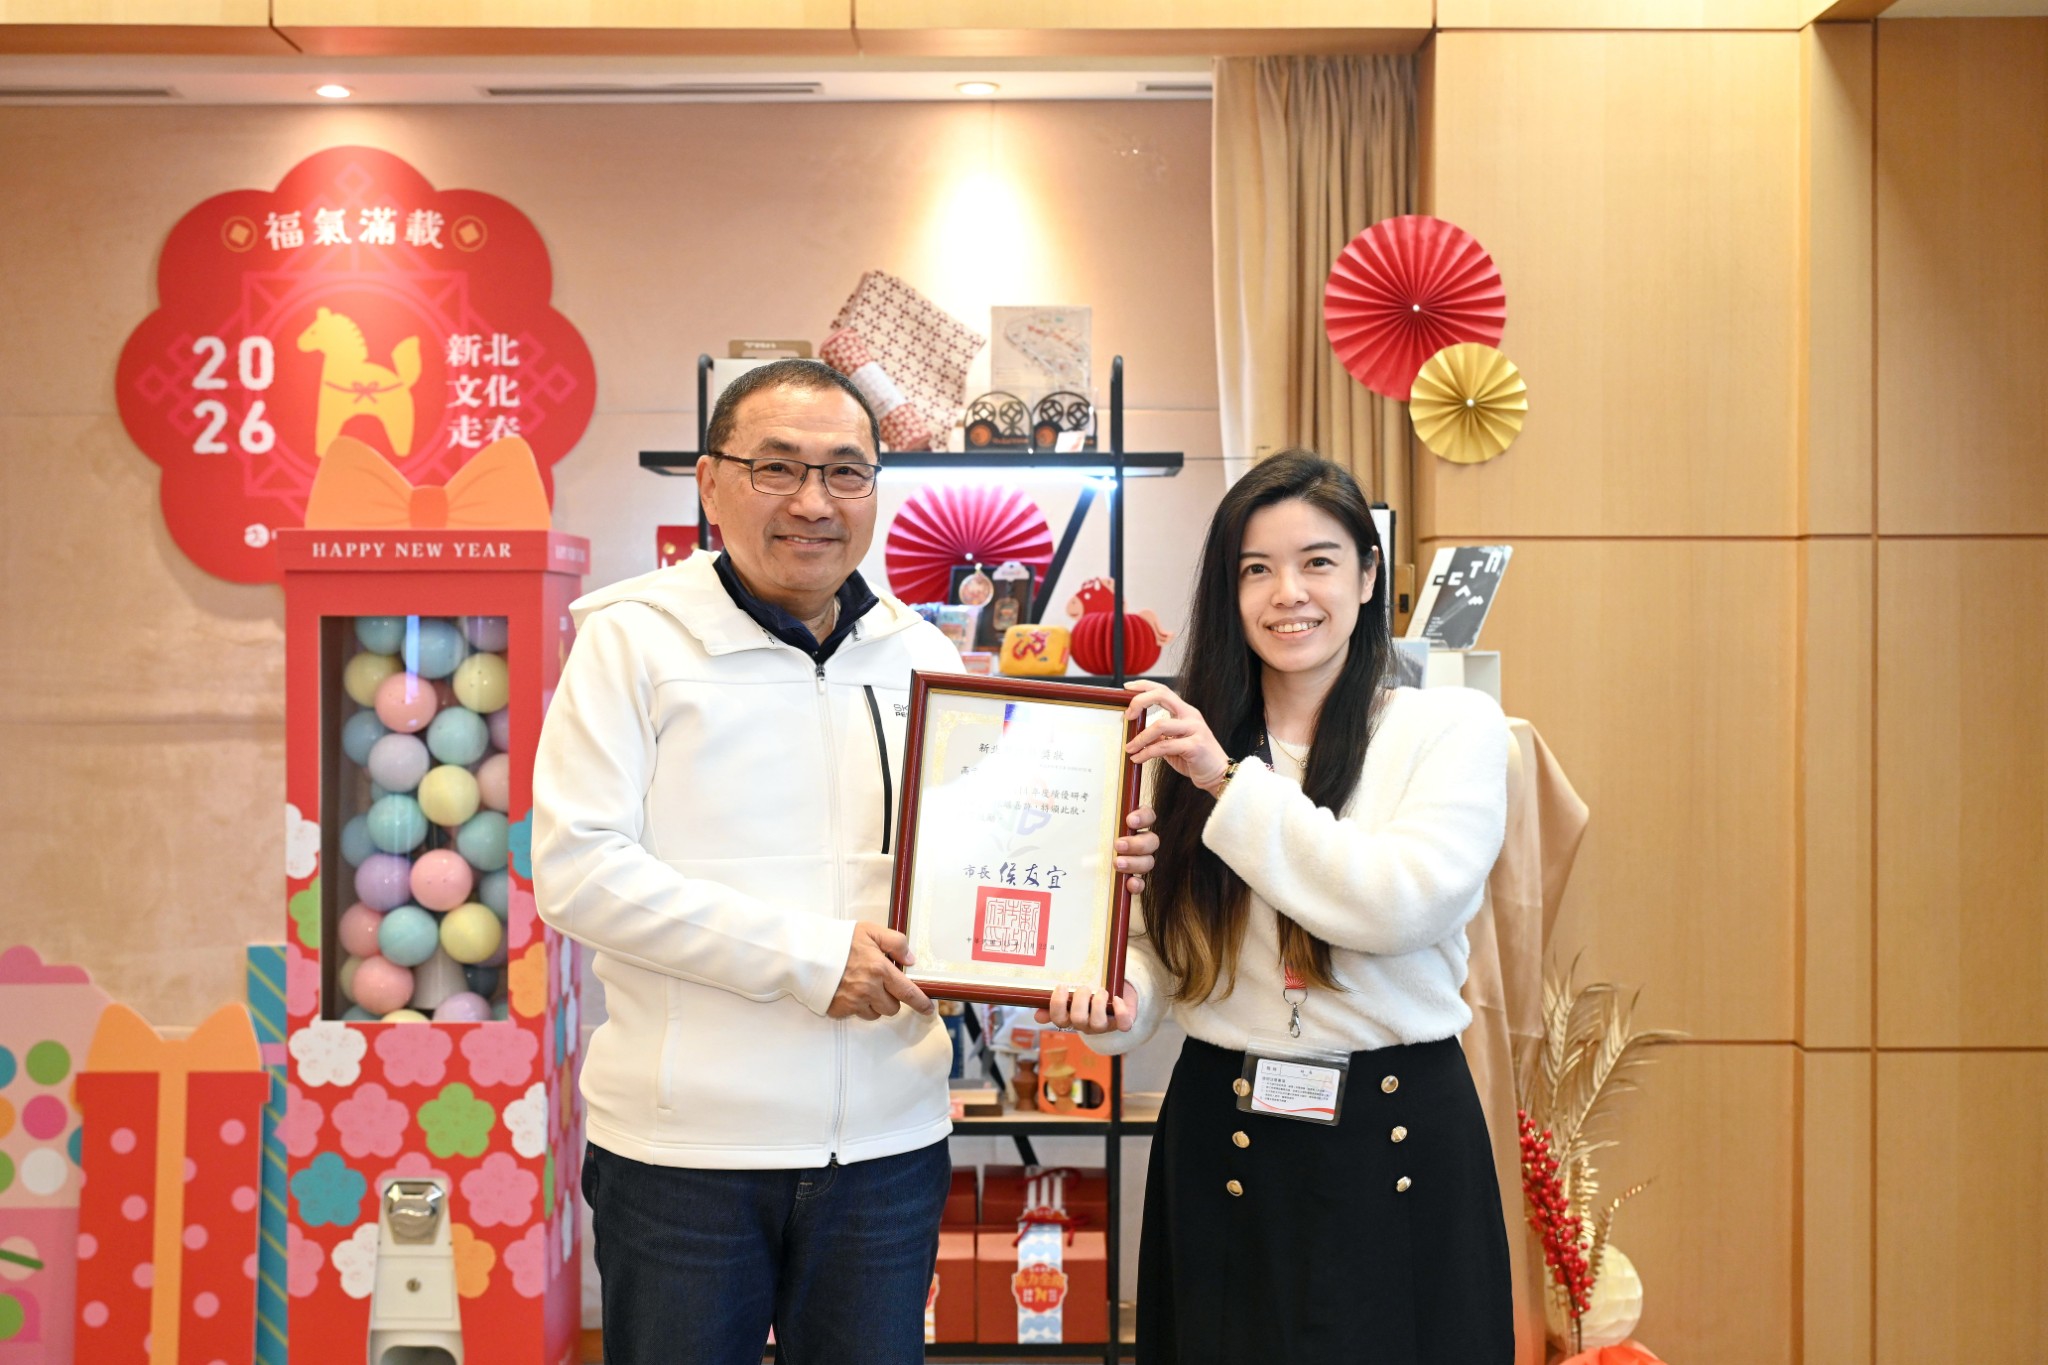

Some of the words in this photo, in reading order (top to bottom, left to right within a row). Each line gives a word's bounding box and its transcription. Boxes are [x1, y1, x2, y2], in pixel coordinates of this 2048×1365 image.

[264, 206, 445, 250] 福氣滿載
[191, 335, 275, 391] 20
[444, 333, 521, 368] 新北
[445, 373, 521, 409] 文化
[192, 399, 276, 455] 26
[446, 414, 521, 449] 走春
[312, 542, 385, 558] HAPPY
[395, 542, 443, 558] NEW
[453, 542, 512, 558] YEAR
[963, 865, 991, 880] 市長
[999, 861, 1067, 889] 侯友宜
